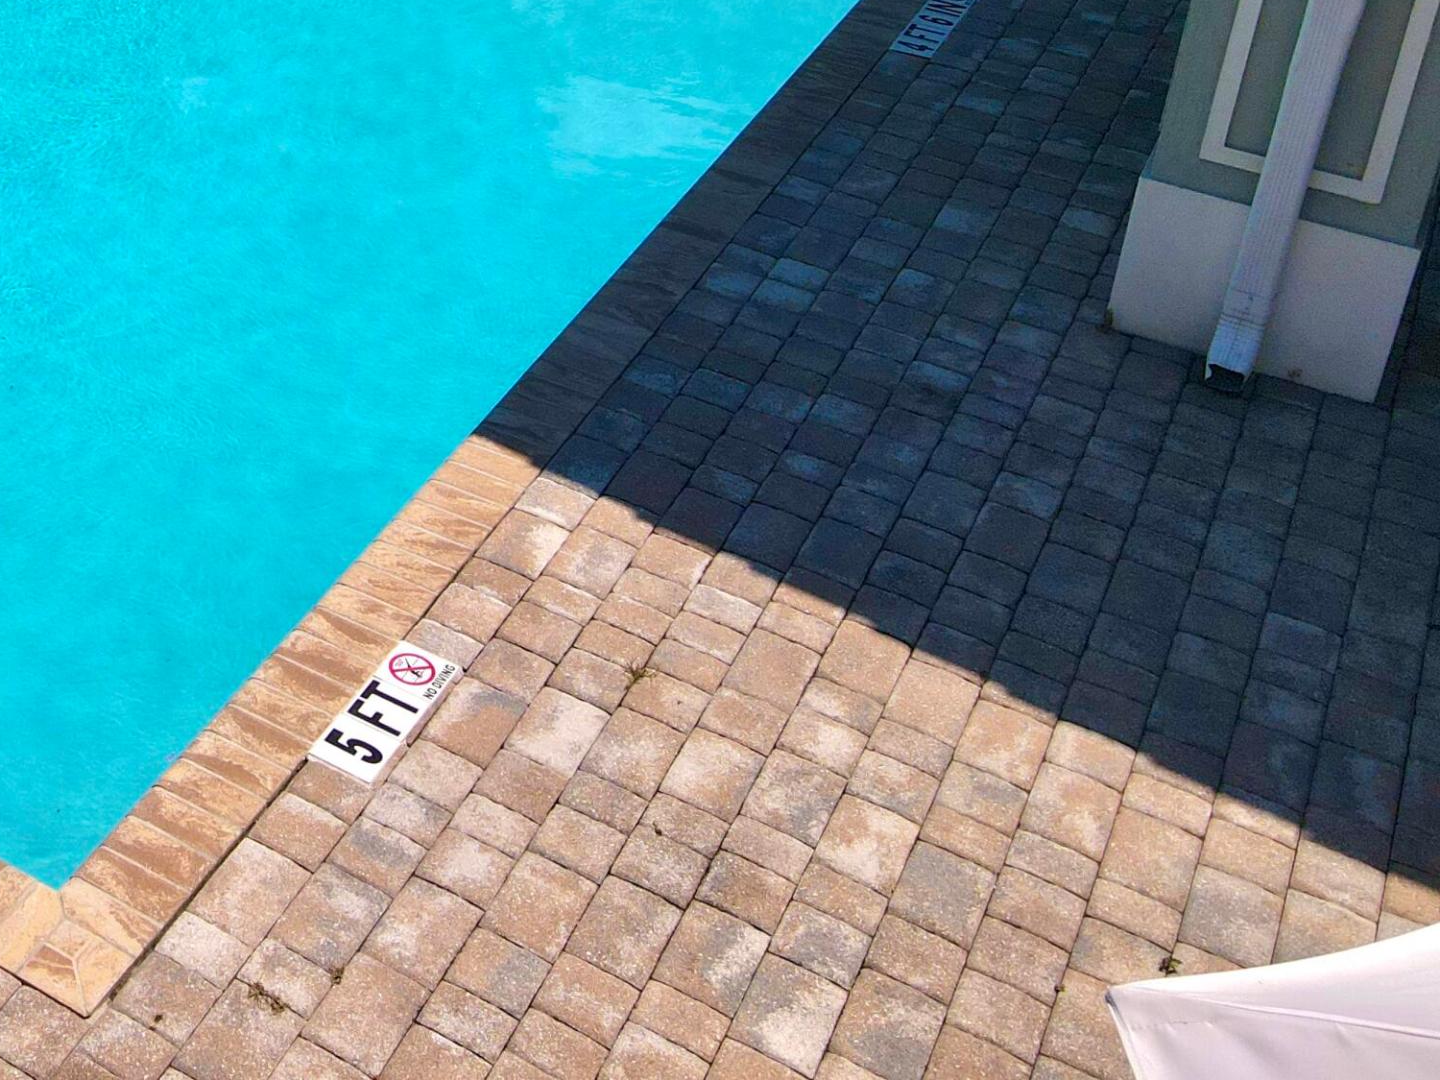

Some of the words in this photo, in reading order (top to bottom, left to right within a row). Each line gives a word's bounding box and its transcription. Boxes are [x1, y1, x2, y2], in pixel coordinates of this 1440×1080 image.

[903, 23, 946, 44] FT
[918, 15, 954, 26] 6
[897, 40, 935, 51] 4
[423, 687, 437, 700] NO
[433, 664, 456, 690] DIVING
[347, 679, 419, 737] FT
[324, 728, 383, 764] 5
